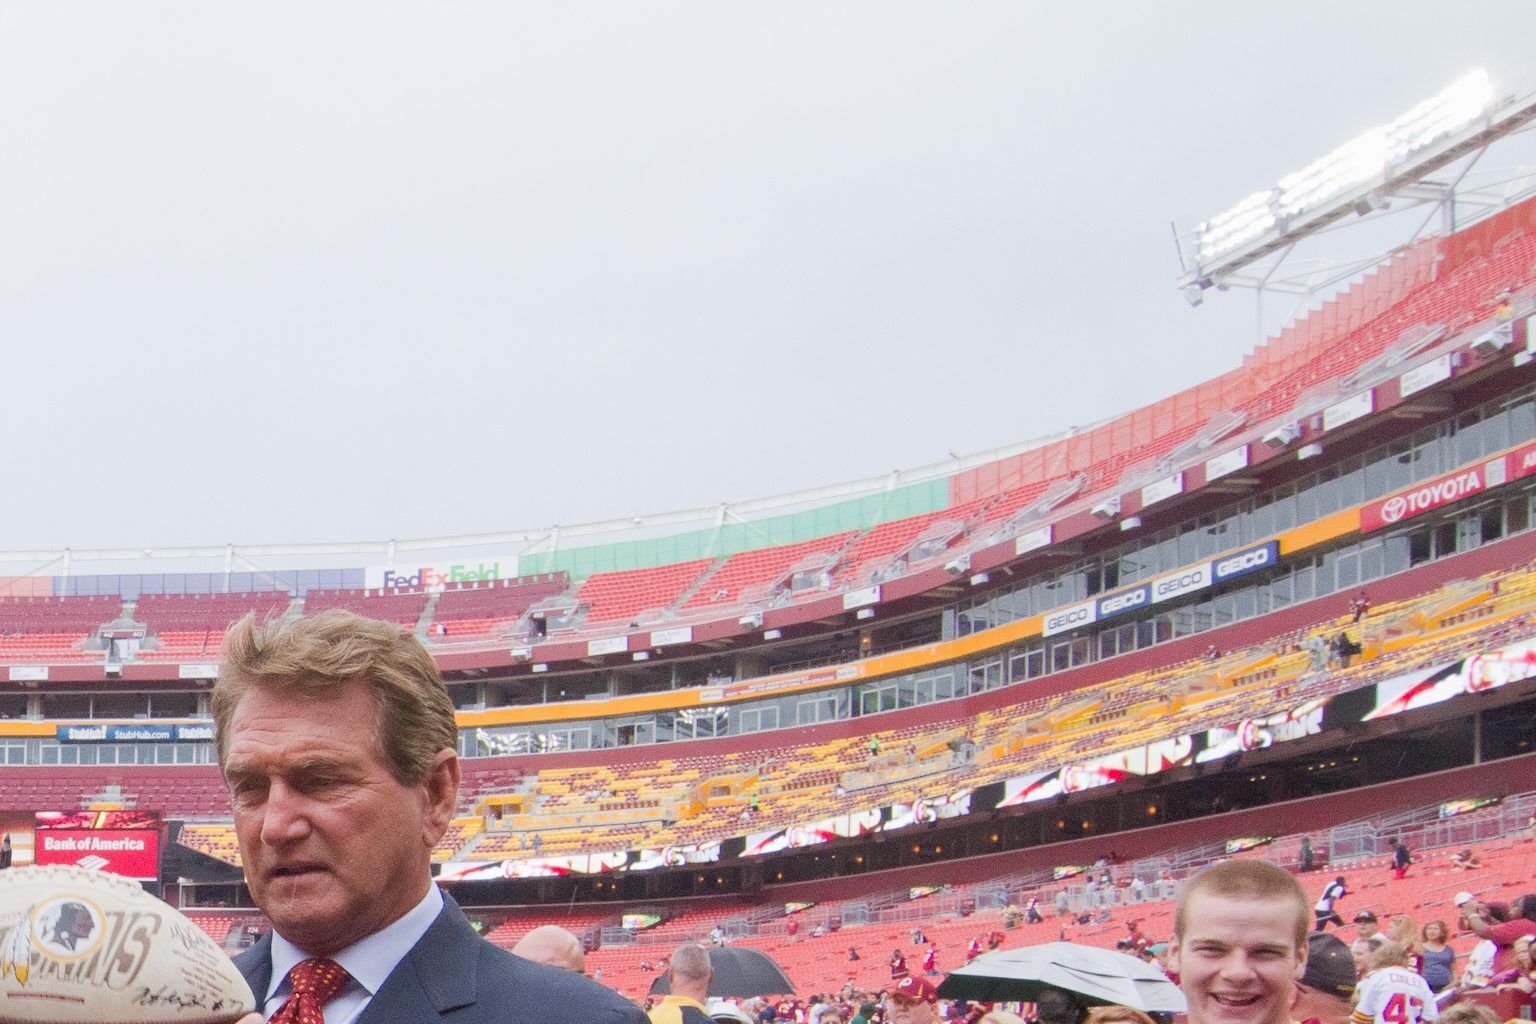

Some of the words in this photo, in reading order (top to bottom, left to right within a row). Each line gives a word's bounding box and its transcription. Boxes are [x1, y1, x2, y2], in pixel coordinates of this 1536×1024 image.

[1406, 471, 1481, 512] TOYOTA
[1216, 548, 1268, 577] GEICO
[1158, 570, 1202, 597] GEICO
[1100, 589, 1146, 615] GEICO
[1048, 608, 1088, 631] GEICO
[114, 729, 170, 740] StubHub.com
[44, 836, 77, 851] Bank
[77, 836, 91, 851] of
[91, 836, 145, 851] America
